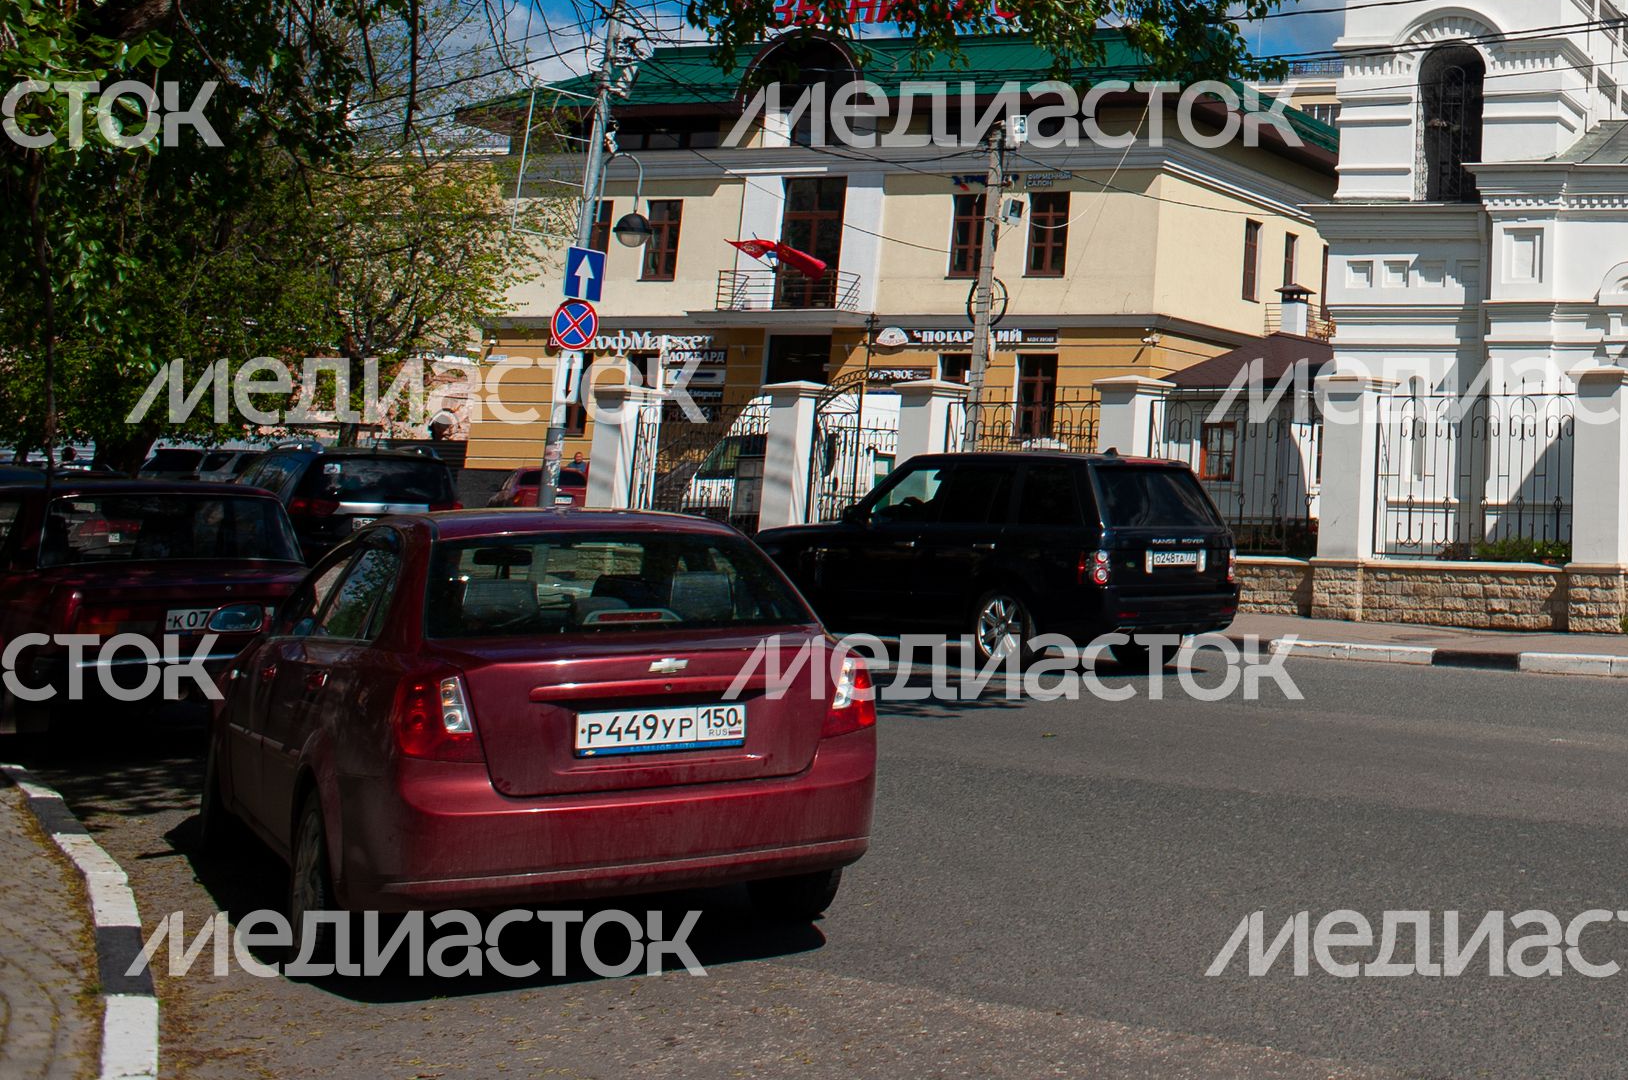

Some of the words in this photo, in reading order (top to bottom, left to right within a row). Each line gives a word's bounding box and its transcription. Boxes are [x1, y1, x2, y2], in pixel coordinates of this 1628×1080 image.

[588, 714, 693, 744] Р449УР
[700, 708, 739, 729] 150
[709, 728, 728, 736] RUS
